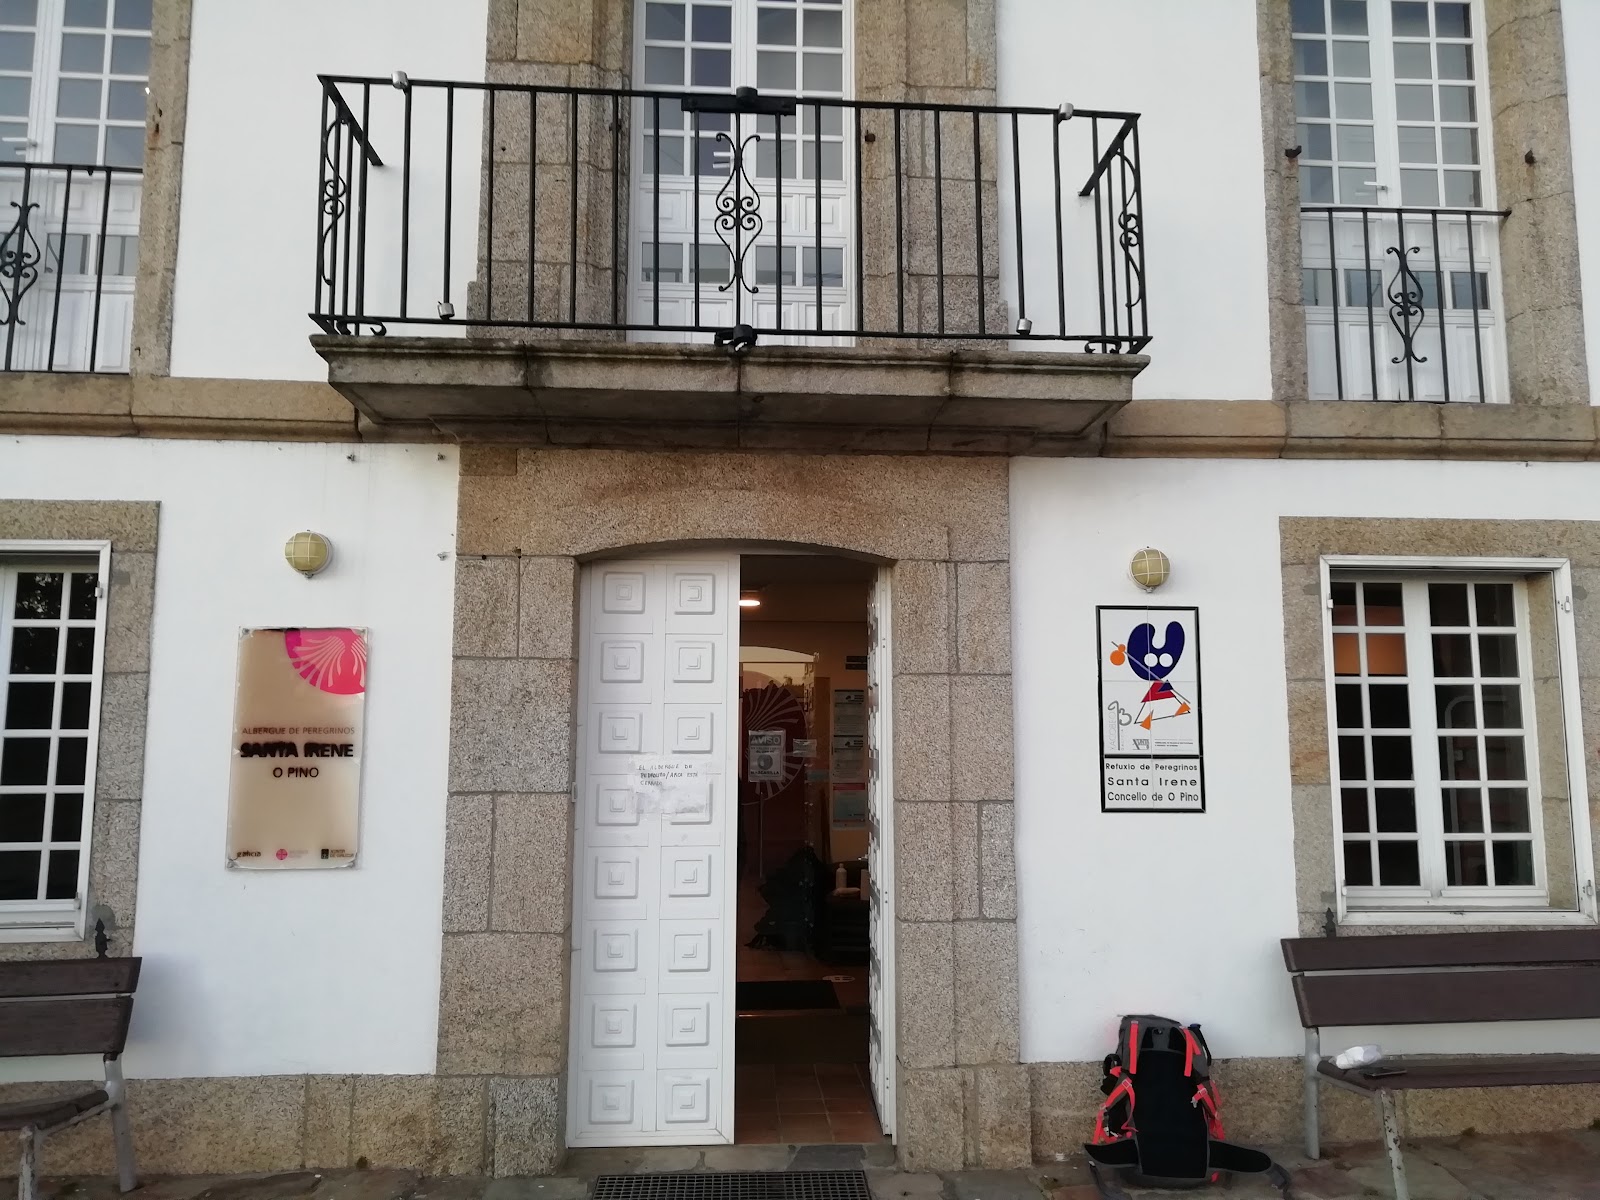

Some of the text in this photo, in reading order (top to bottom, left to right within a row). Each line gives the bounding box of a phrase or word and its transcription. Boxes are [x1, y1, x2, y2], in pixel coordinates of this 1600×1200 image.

[242, 727, 355, 735] ALBERGUE DE PEREGRINOS
[750, 736, 781, 745] AVISO
[240, 741, 354, 758] SANTA IRENE
[272, 767, 319, 778] O PINO
[1105, 762, 1198, 772] Refuxio de Peregrinos
[1107, 776, 1198, 787] Santa Irene
[1107, 791, 1199, 802] Concello de O Pino
